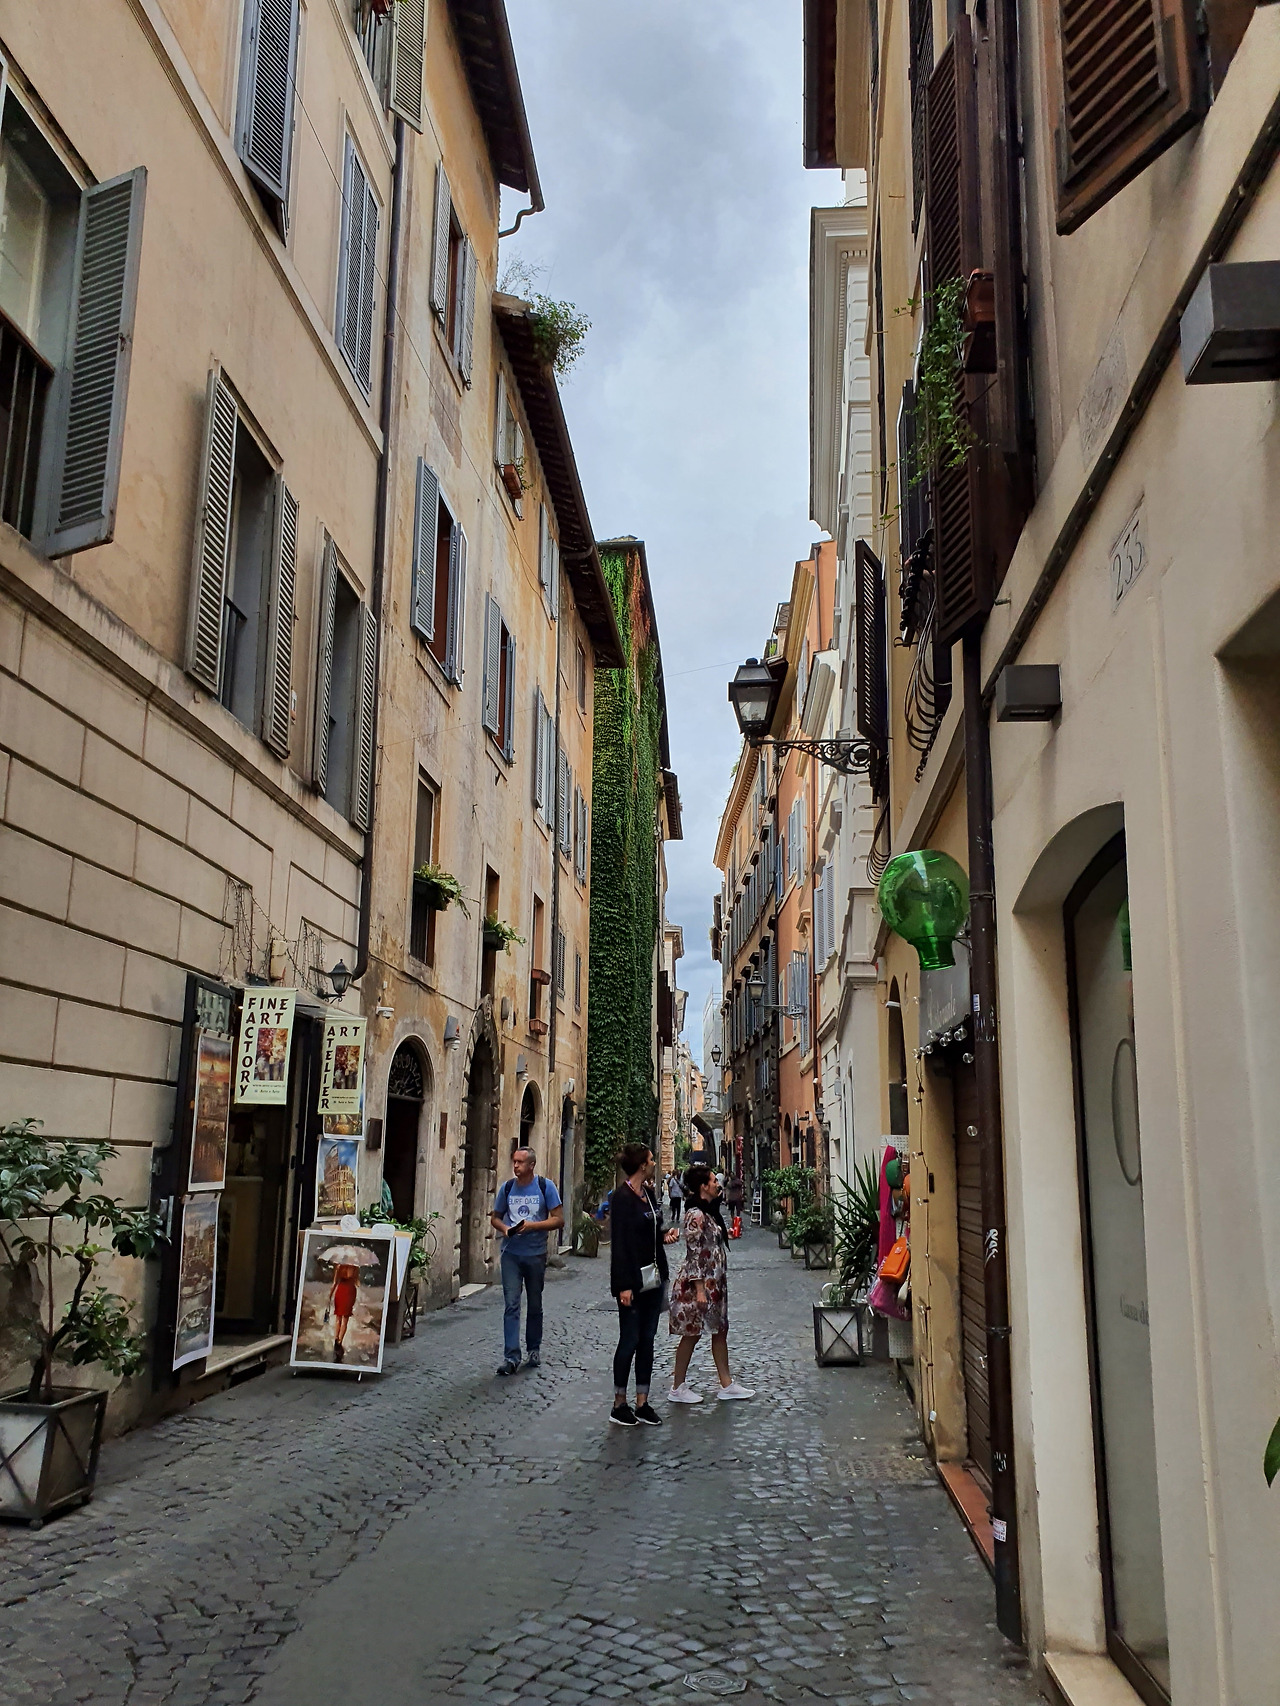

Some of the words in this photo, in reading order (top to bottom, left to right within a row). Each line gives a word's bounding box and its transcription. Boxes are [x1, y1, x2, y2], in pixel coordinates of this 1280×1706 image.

[248, 997, 289, 1011] FINE
[246, 1011, 284, 1026] ART
[327, 1026, 361, 1037] ART
[321, 1026, 336, 1110] ATELIER
